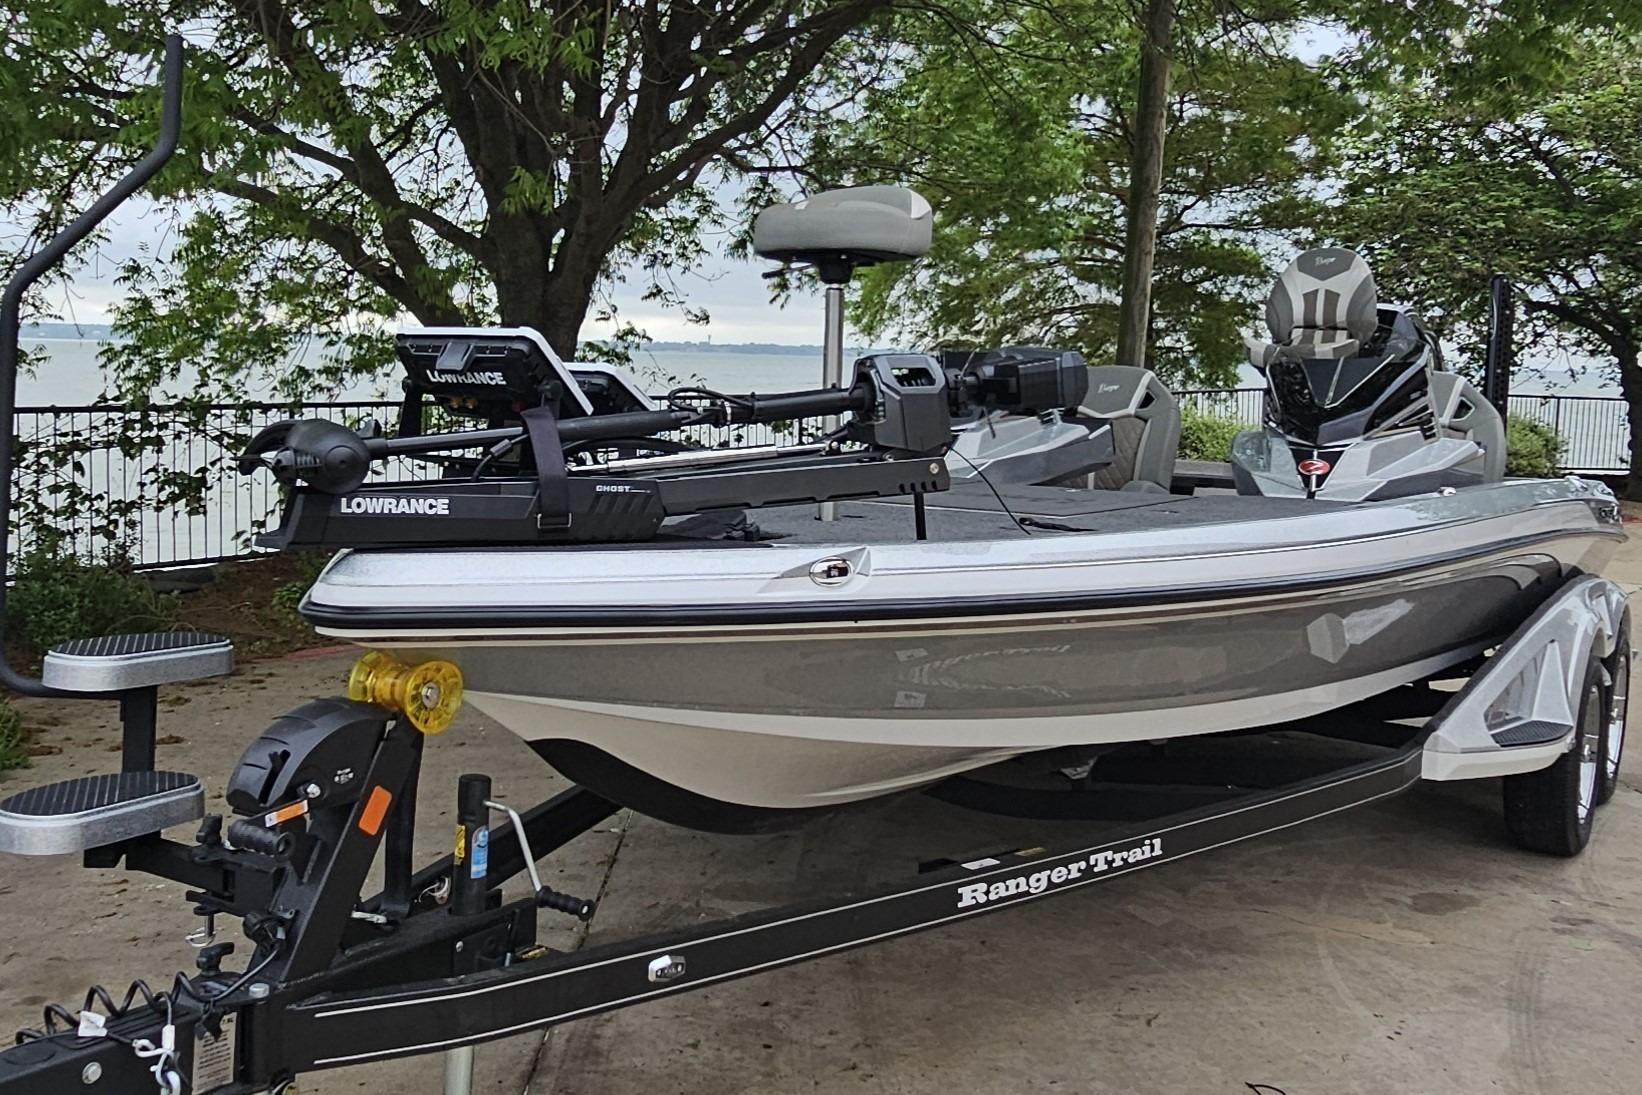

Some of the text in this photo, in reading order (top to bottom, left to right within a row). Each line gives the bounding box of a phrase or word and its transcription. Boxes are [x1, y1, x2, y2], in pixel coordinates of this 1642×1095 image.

[426, 369, 507, 385] LOWRANCE
[340, 497, 450, 515] LOWRANCE
[957, 838, 1163, 908] Ranger Trail
